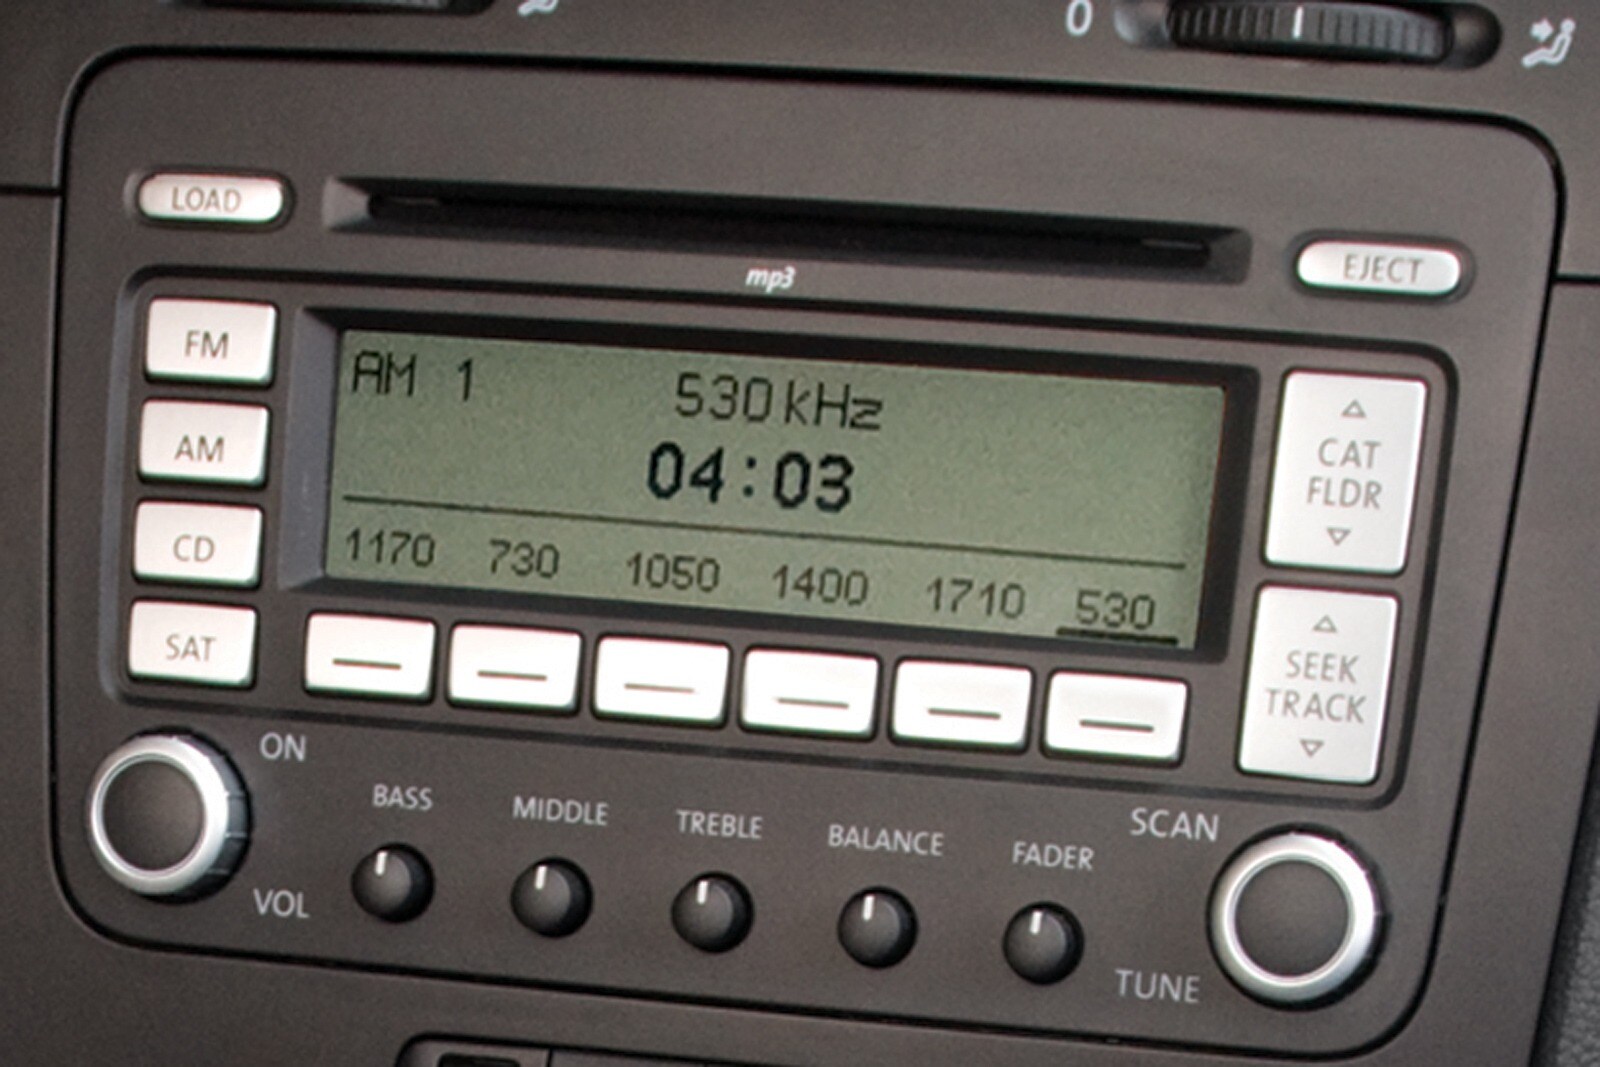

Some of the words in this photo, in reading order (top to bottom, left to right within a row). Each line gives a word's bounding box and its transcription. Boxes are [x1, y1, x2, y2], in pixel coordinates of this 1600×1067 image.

[1067, 0, 1092, 35] 0
[171, 187, 242, 212] LOAD
[746, 266, 796, 293] mp3
[1343, 253, 1425, 284] EJECT
[186, 331, 228, 357] FM
[353, 350, 416, 396] AM
[458, 359, 472, 401] 1
[175, 435, 224, 461] AM
[1319, 438, 1381, 468] CAT
[648, 442, 853, 512] 04:03
[1308, 477, 1382, 509] FLDR
[173, 534, 214, 562] CD
[347, 528, 435, 567] 1170
[490, 539, 559, 579] 730
[627, 552, 720, 593] 1050
[773, 565, 868, 606] 1400
[927, 578, 1025, 619] 1710
[1076, 590, 1156, 629] 530
[167, 634, 215, 660] SAT
[1288, 651, 1358, 683] SEEK
[1270, 689, 1366, 723] TRACK
[261, 733, 305, 761] ON
[374, 784, 432, 810] BASS
[514, 796, 607, 825] MIDDLE
[678, 810, 762, 839] TREBLE
[1132, 808, 1218, 841] SCAN
[829, 825, 943, 855] BALANCE
[1013, 842, 1093, 869] FADER
[254, 889, 308, 918] VOL
[1116, 969, 1198, 1003] TUNE
